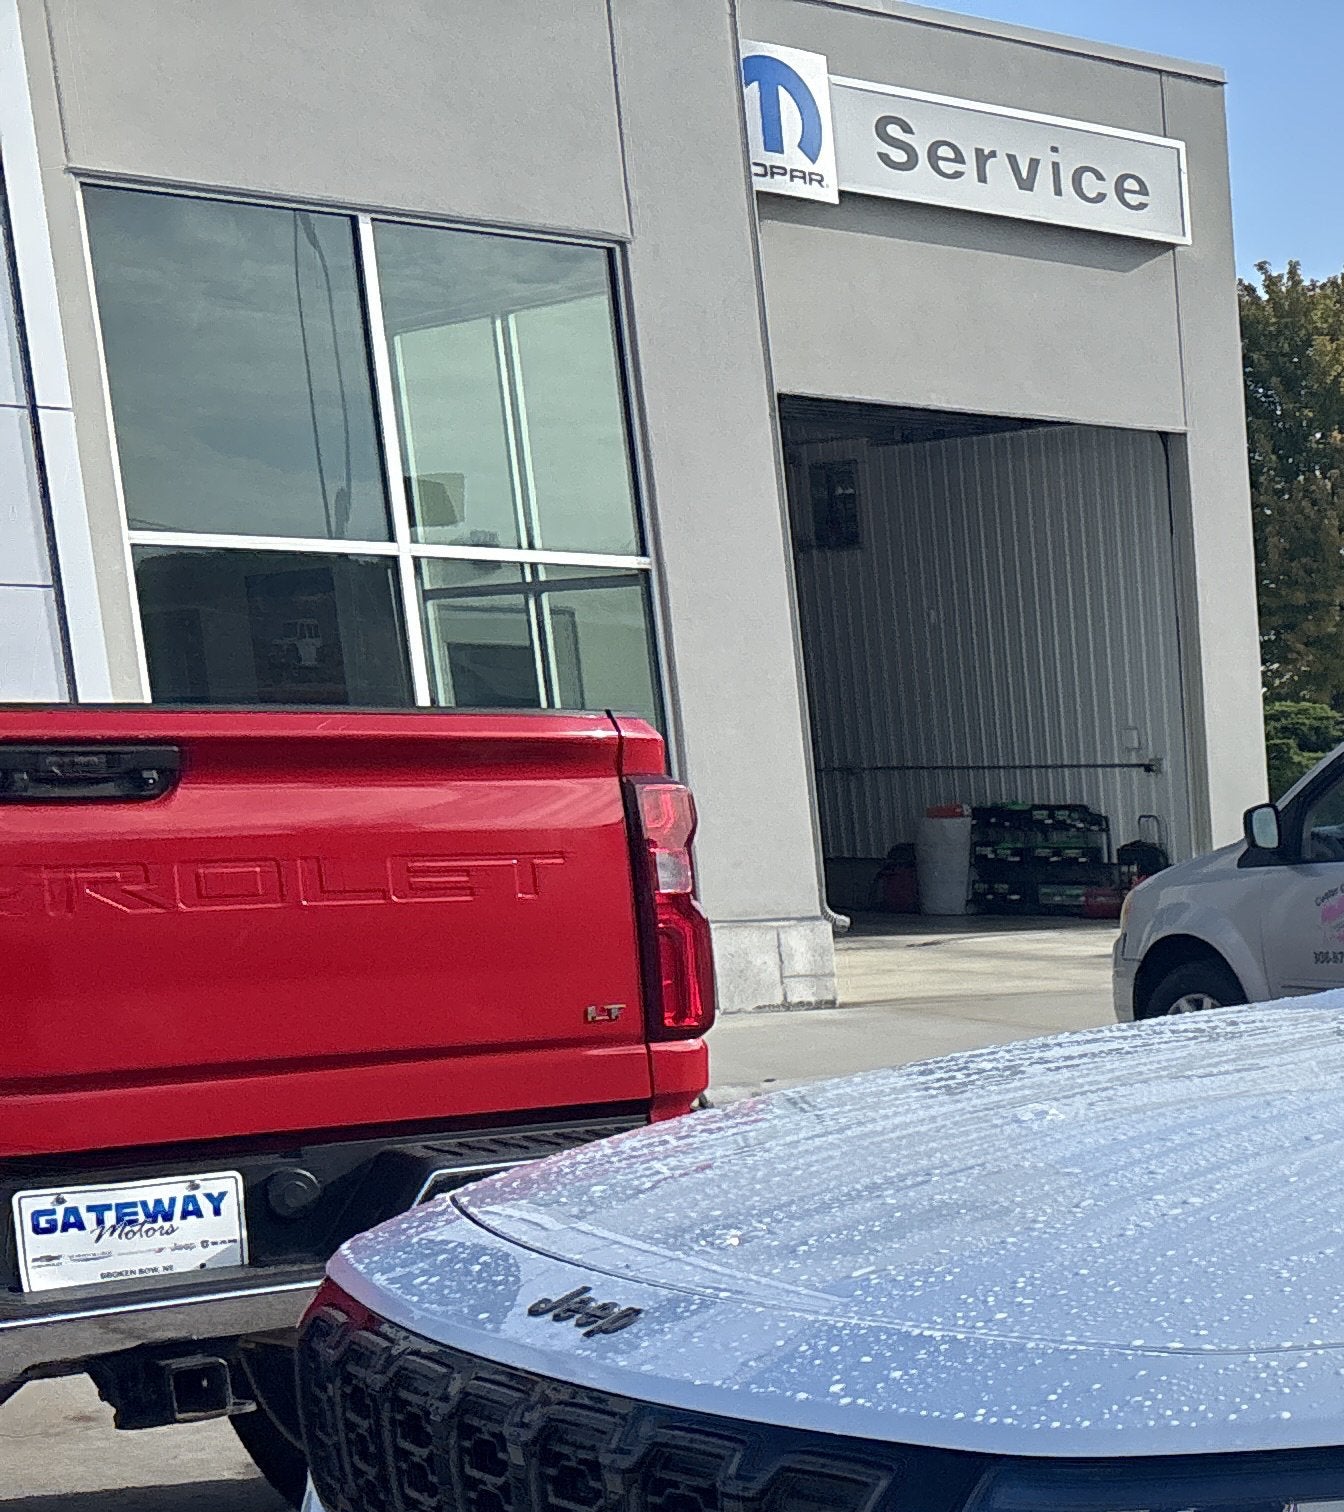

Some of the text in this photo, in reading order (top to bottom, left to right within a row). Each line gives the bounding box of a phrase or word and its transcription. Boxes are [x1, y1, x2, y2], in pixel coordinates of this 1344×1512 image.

[752, 162, 825, 188] OPAR
[874, 115, 1150, 211] Service
[0, 852, 566, 916] ROLET
[587, 1004, 626, 1021] LT
[31, 1191, 228, 1235] GATEWAY
[91, 1218, 179, 1243] Motors
[527, 1285, 645, 1338] Jeep
